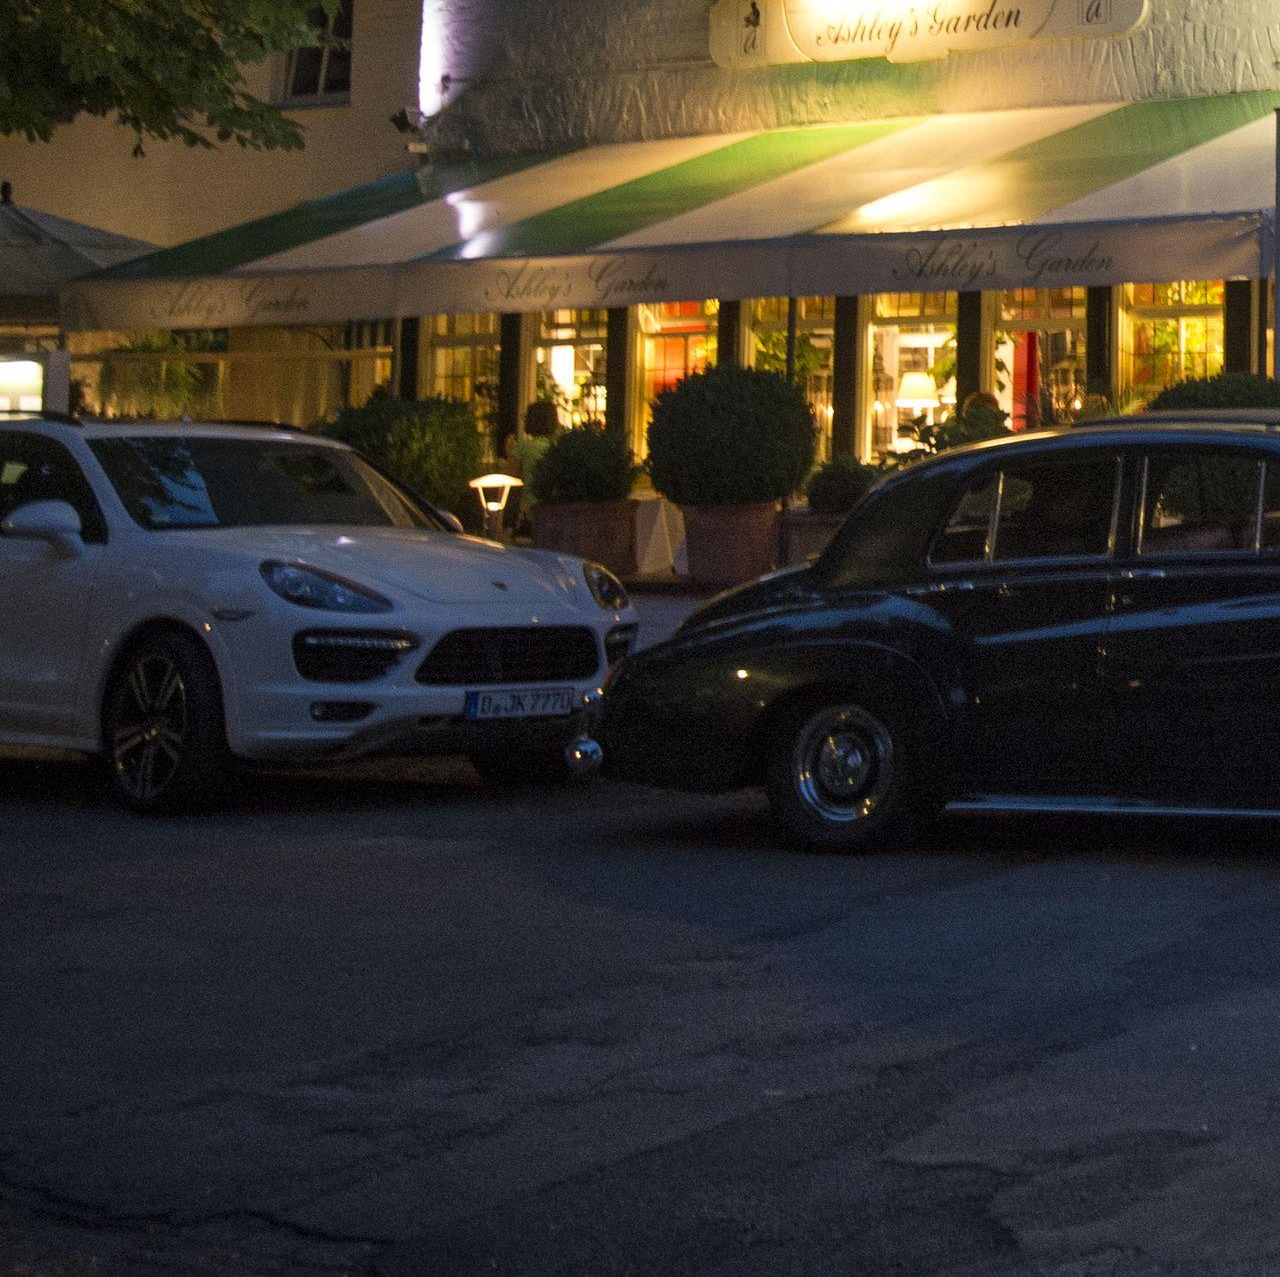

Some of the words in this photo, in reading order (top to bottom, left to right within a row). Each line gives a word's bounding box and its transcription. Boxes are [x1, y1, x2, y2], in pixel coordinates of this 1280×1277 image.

[815, 4, 919, 54] Ashley's
[485, 260, 571, 306] Ashley's
[588, 255, 668, 303] Garden
[892, 236, 998, 289] Ashley's
[1016, 231, 1114, 280] Garden
